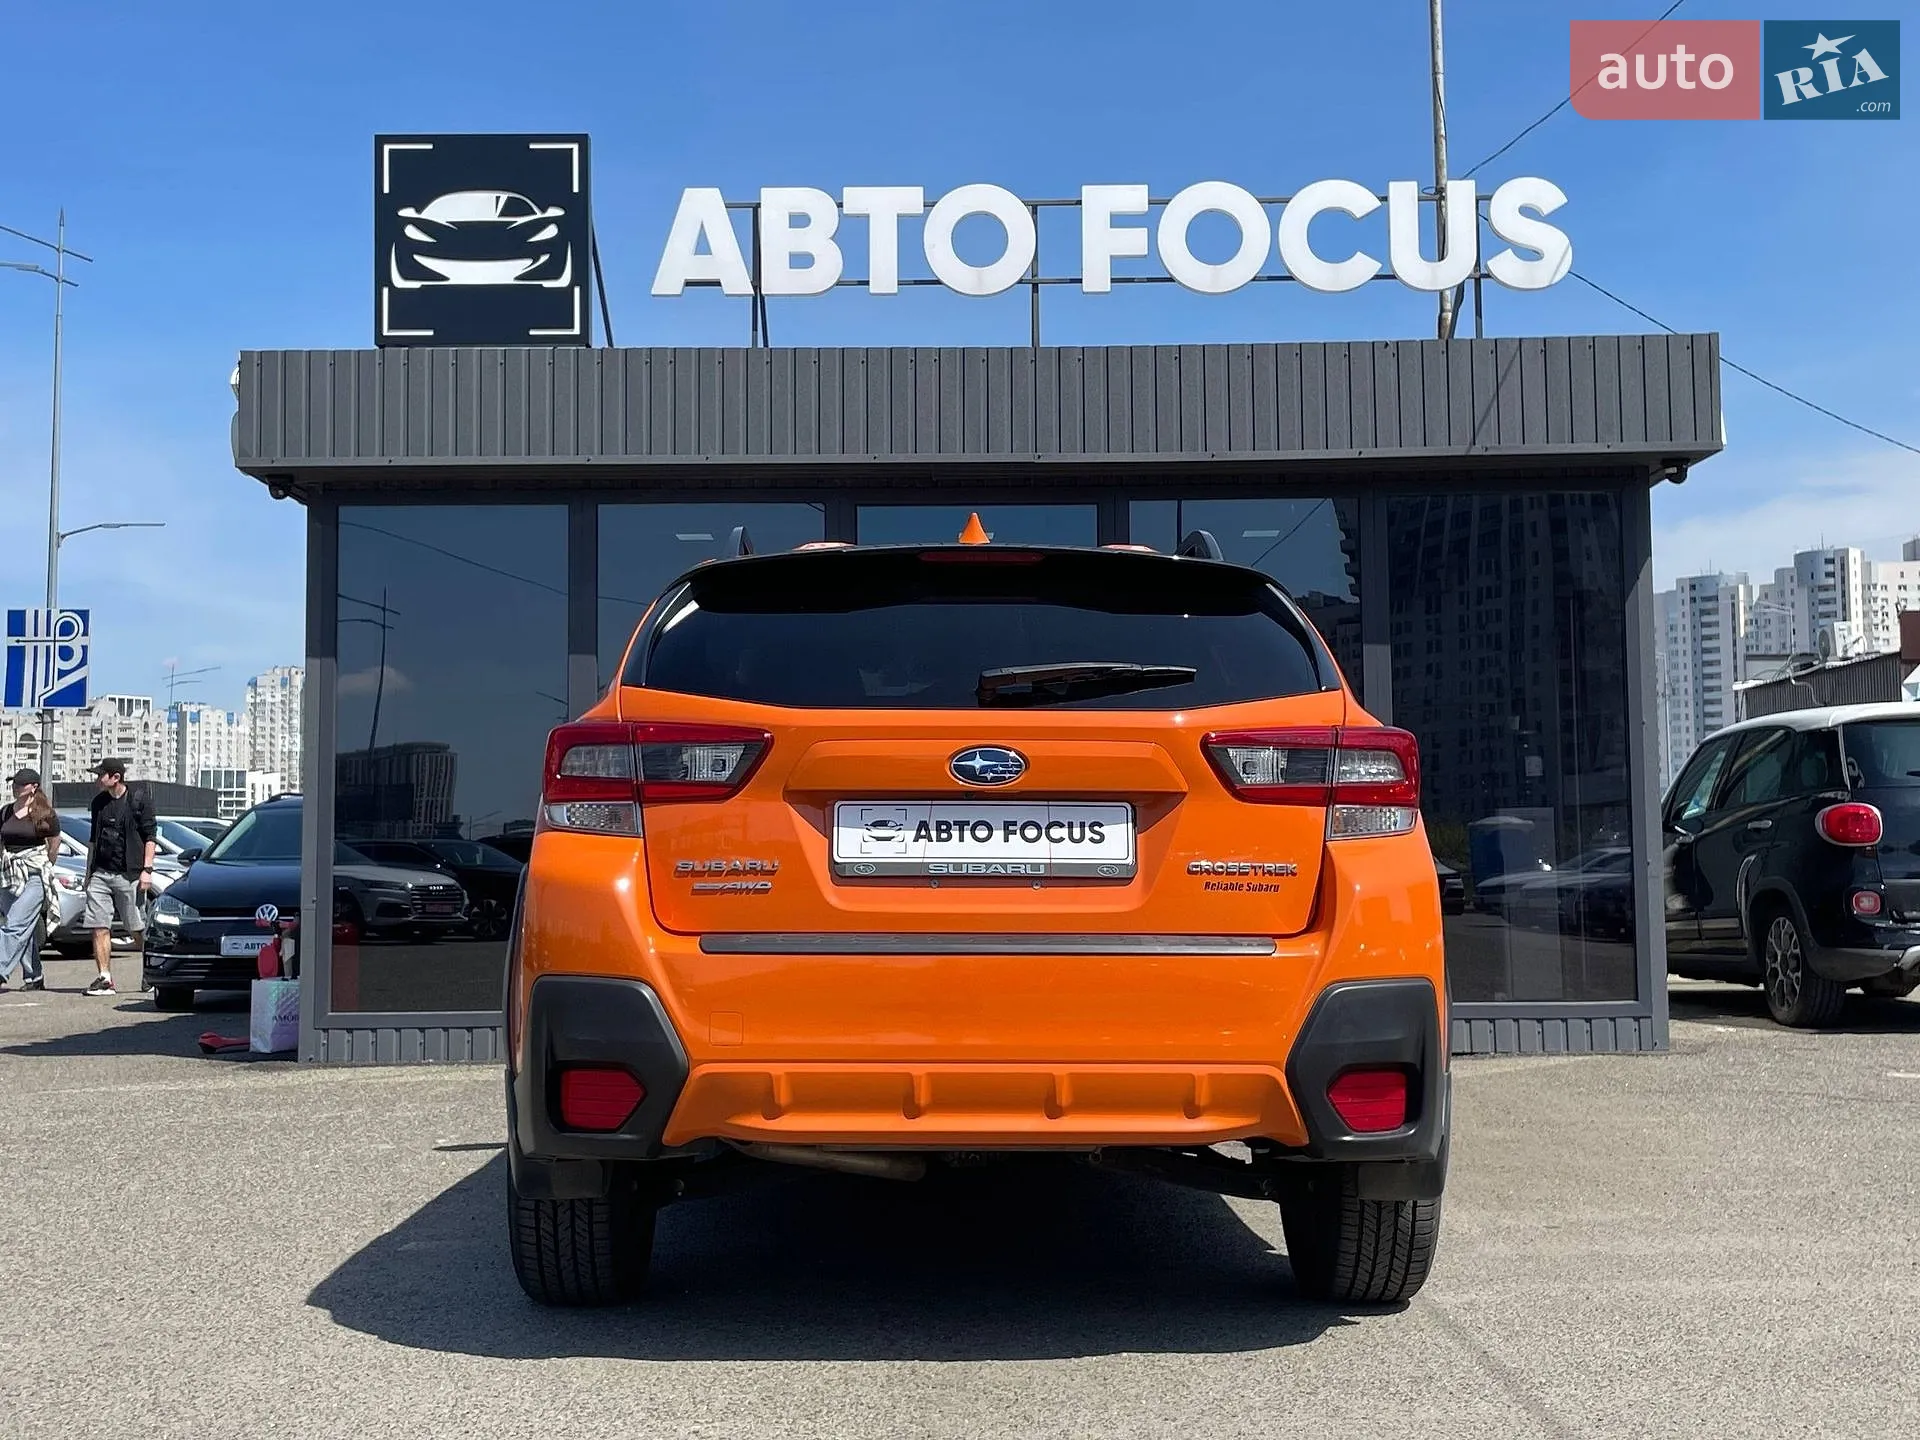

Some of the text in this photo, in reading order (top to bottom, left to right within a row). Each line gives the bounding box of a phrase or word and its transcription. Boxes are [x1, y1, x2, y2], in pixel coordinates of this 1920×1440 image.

[651, 177, 1574, 297] АВТО FOCUS
[912, 819, 1106, 844] АВТО FOCUS
[674, 859, 780, 876] SUBARU
[927, 863, 1045, 875] SUBARU
[1187, 860, 1298, 876] CROSSTREK
[1204, 881, 1280, 893] Reliable Subaru
